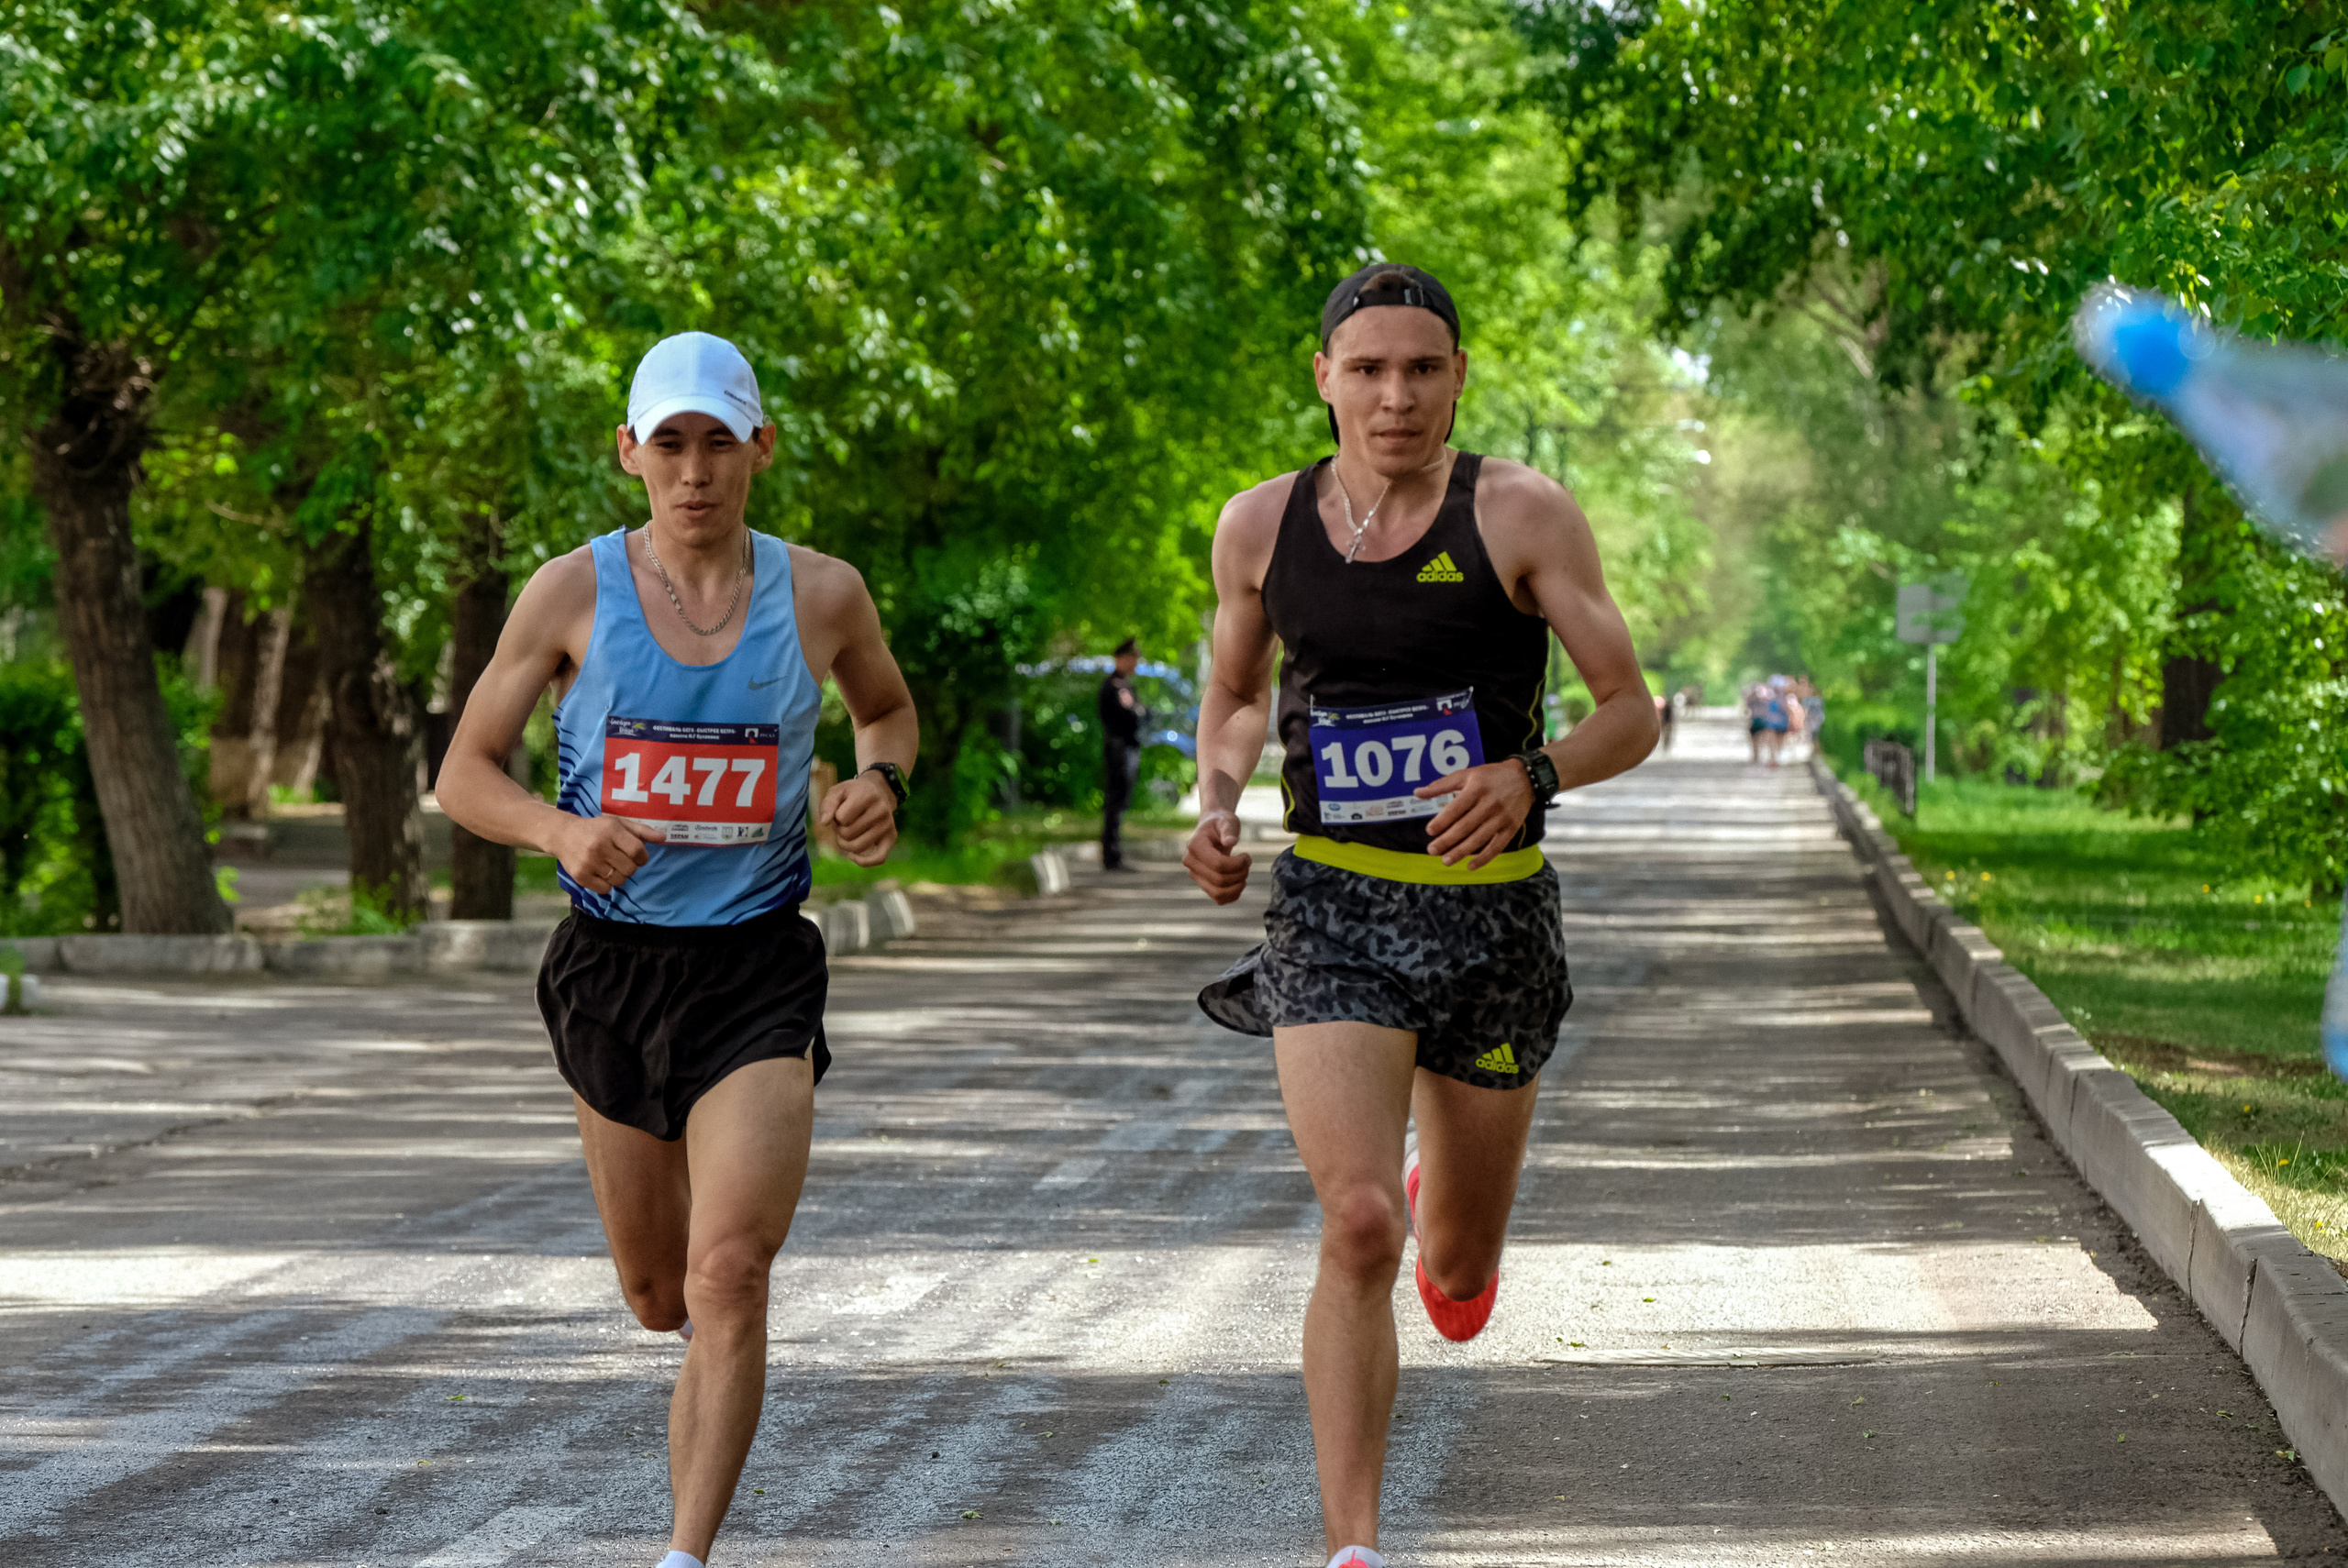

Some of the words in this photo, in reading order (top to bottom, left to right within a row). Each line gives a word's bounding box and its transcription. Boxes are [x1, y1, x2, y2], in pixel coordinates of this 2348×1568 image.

[1416, 570, 1464, 582] adidas
[1321, 729, 1469, 788] 1076
[611, 752, 766, 807] 1477
[1475, 1058, 1519, 1074] adidas
